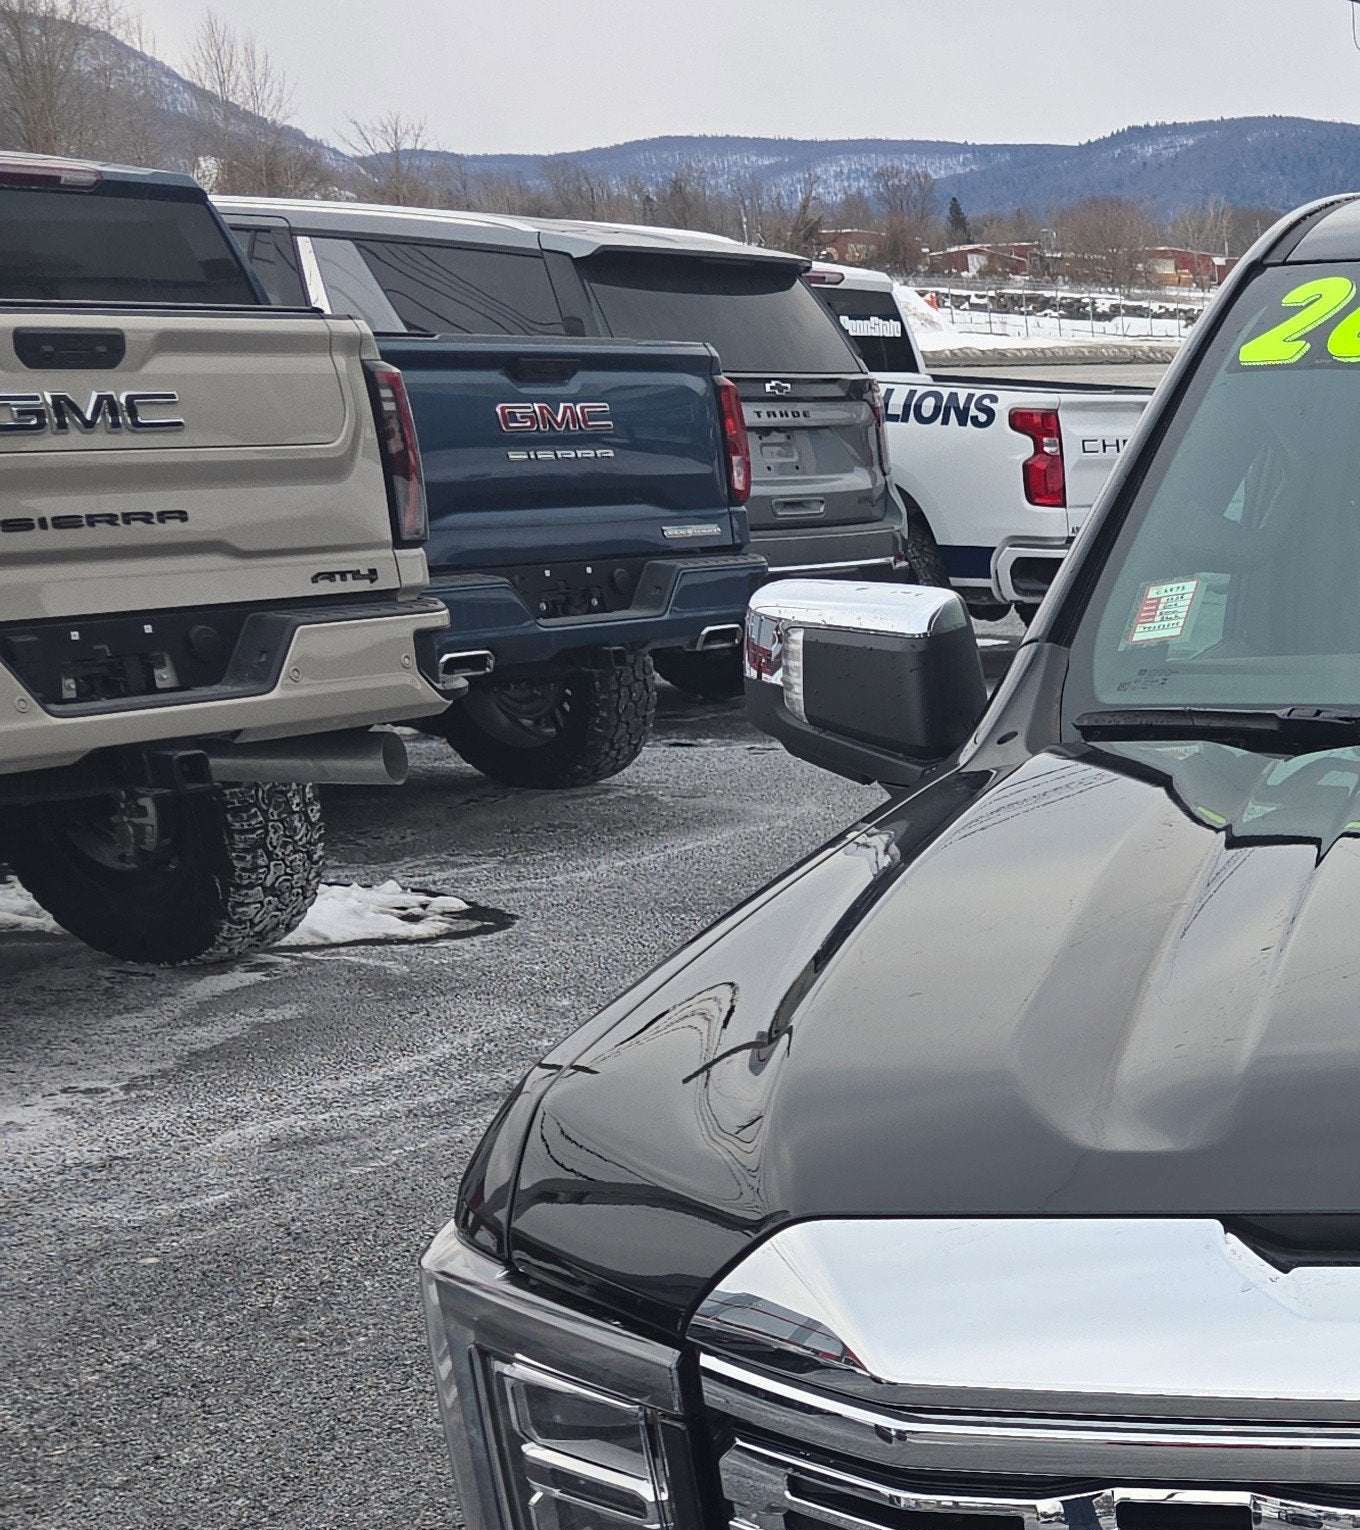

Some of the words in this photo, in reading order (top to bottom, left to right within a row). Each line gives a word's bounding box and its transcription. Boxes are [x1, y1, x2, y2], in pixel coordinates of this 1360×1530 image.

[0, 391, 186, 435] GMC
[496, 402, 613, 433] GMC
[753, 409, 811, 420] TAHOE
[883, 388, 999, 429] LIONS
[507, 449, 614, 462] SIERRA
[0, 510, 190, 534] SIERRA
[310, 568, 379, 585] AT4
